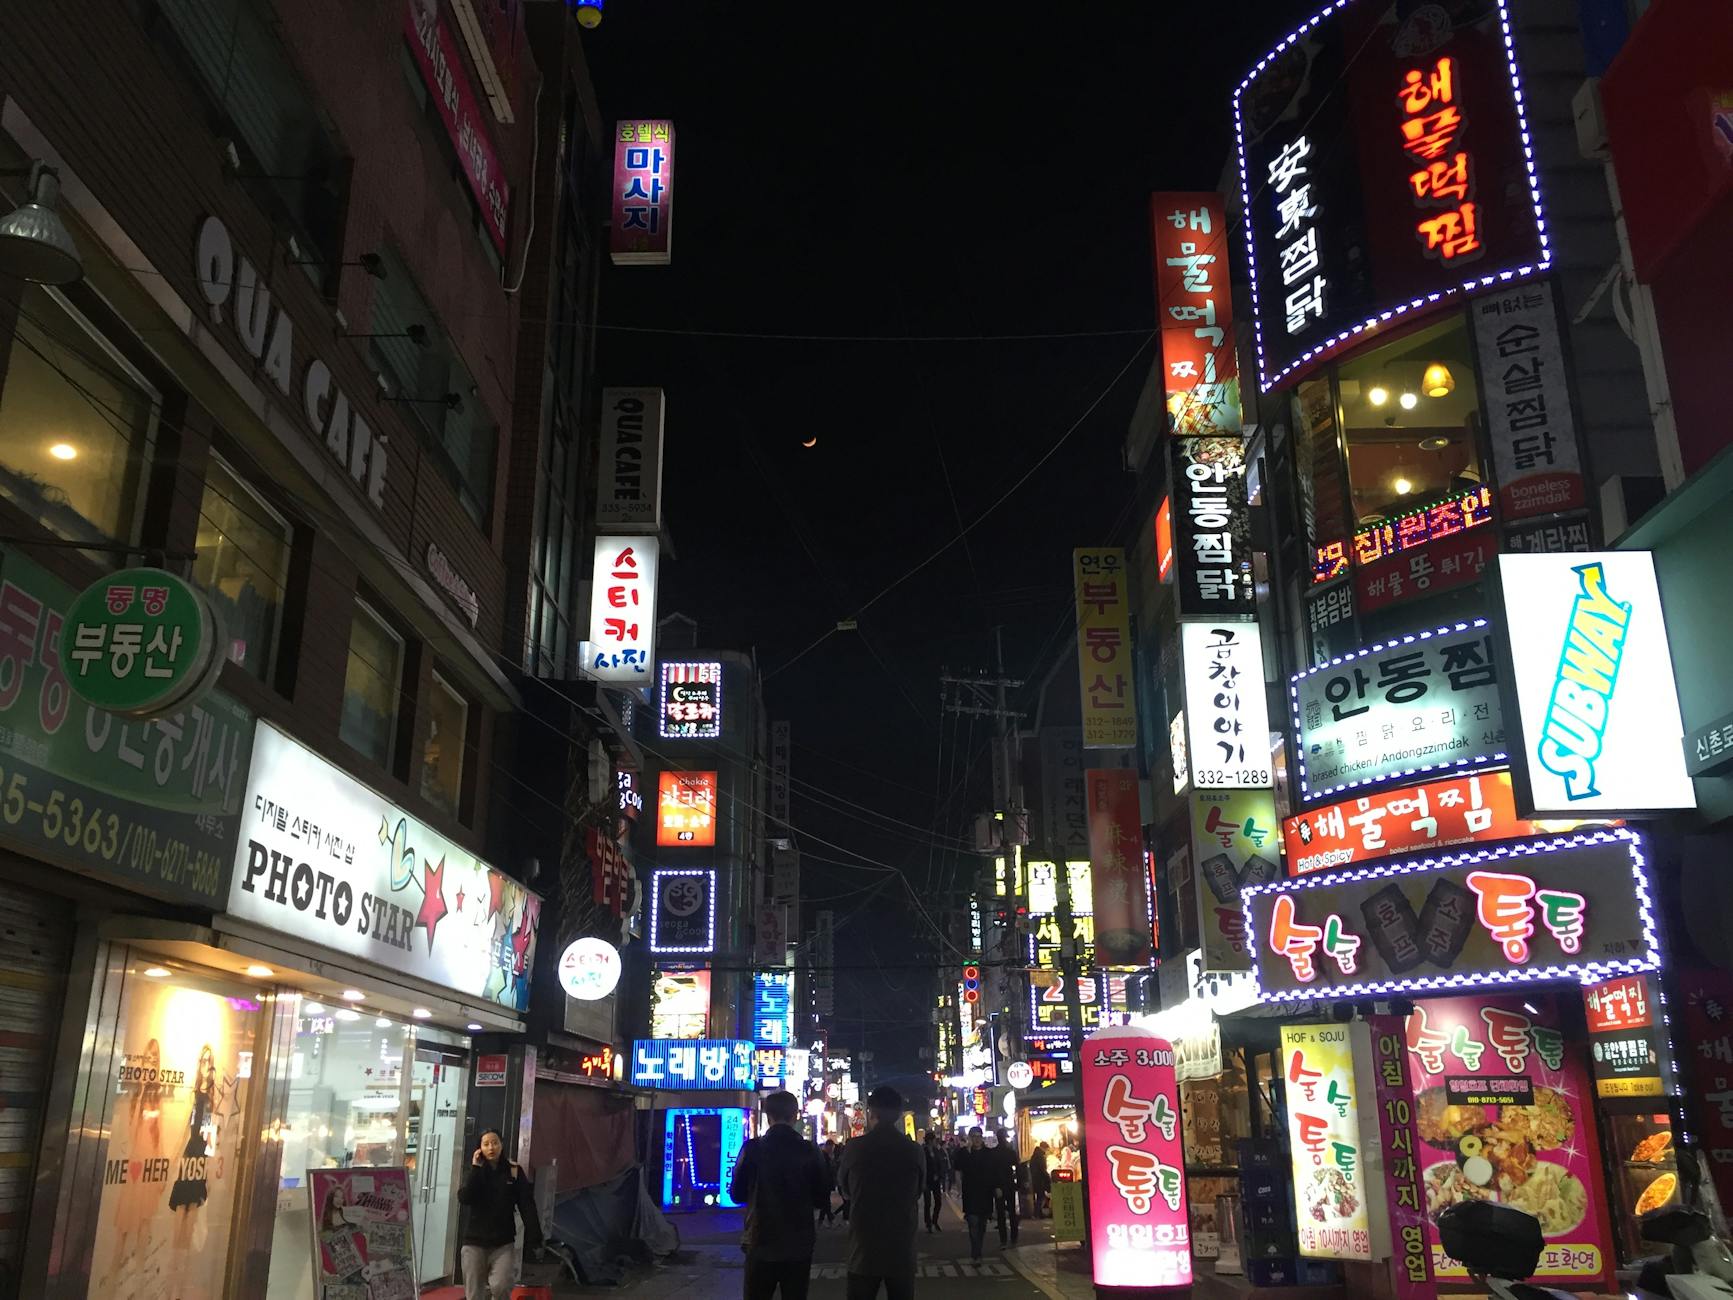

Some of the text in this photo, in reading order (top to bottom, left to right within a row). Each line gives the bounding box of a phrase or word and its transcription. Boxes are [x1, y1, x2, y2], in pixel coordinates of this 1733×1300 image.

[619, 123, 670, 143] 호텔식
[1399, 57, 1479, 258] 해물떡찜
[623, 147, 665, 235] 마사지
[1268, 136, 1326, 333] 安東찜닭
[197, 215, 293, 396] QUA
[1497, 324, 1556, 470] 순살찜닭
[1510, 478, 1570, 498] boneless
[1514, 490, 1570, 511] zzimdak
[1080, 554, 1120, 574] 연우
[1186, 462, 1239, 600] 안동찜닭
[106, 585, 169, 617] 동명
[604, 547, 638, 641] 스티커
[71, 622, 183, 679] 부동산
[594, 648, 645, 672] 사진
[1083, 581, 1127, 709] 부동산
[1325, 635, 1498, 721] 안동찜
[1537, 562, 1632, 801] SUBWAY
[1198, 770, 1268, 784] 332-1289
[1312, 767, 1337, 783] brased
[1340, 757, 1371, 778] chicken
[1382, 737, 1469, 764] Andongzzimdak
[291, 815, 322, 853] 스티커
[325, 834, 343, 859] 사진
[345, 843, 356, 865] 샵
[1314, 777, 1492, 850] 해물떡찜
[1297, 854, 1315, 872] Hot
[1324, 848, 1353, 869] Spicy
[242, 839, 353, 926] PHOTO
[357, 892, 415, 952] STAR
[1428, 896, 1461, 957] 소주
[1467, 871, 1586, 965] 통통
[1269, 894, 1361, 982] 술술
[636, 1047, 730, 1081] 노래방
[1094, 1049, 1129, 1066] 소주
[1287, 1032, 1307, 1043] HOF
[1319, 1031, 1345, 1043] SOJU
[1405, 1006, 1484, 1073] 술술
[1481, 1006, 1563, 1074] 통통
[118, 1065, 185, 1085] PHOTO STAR
[1103, 1075, 1176, 1142] 술술
[1290, 1050, 1351, 1117] 술술
[105, 1158, 170, 1185] ME HER
[1106, 1145, 1181, 1214] 통통
[1295, 1112, 1357, 1182] 통통
[1379, 1034, 1427, 1283] 아침 10시까지 영업
